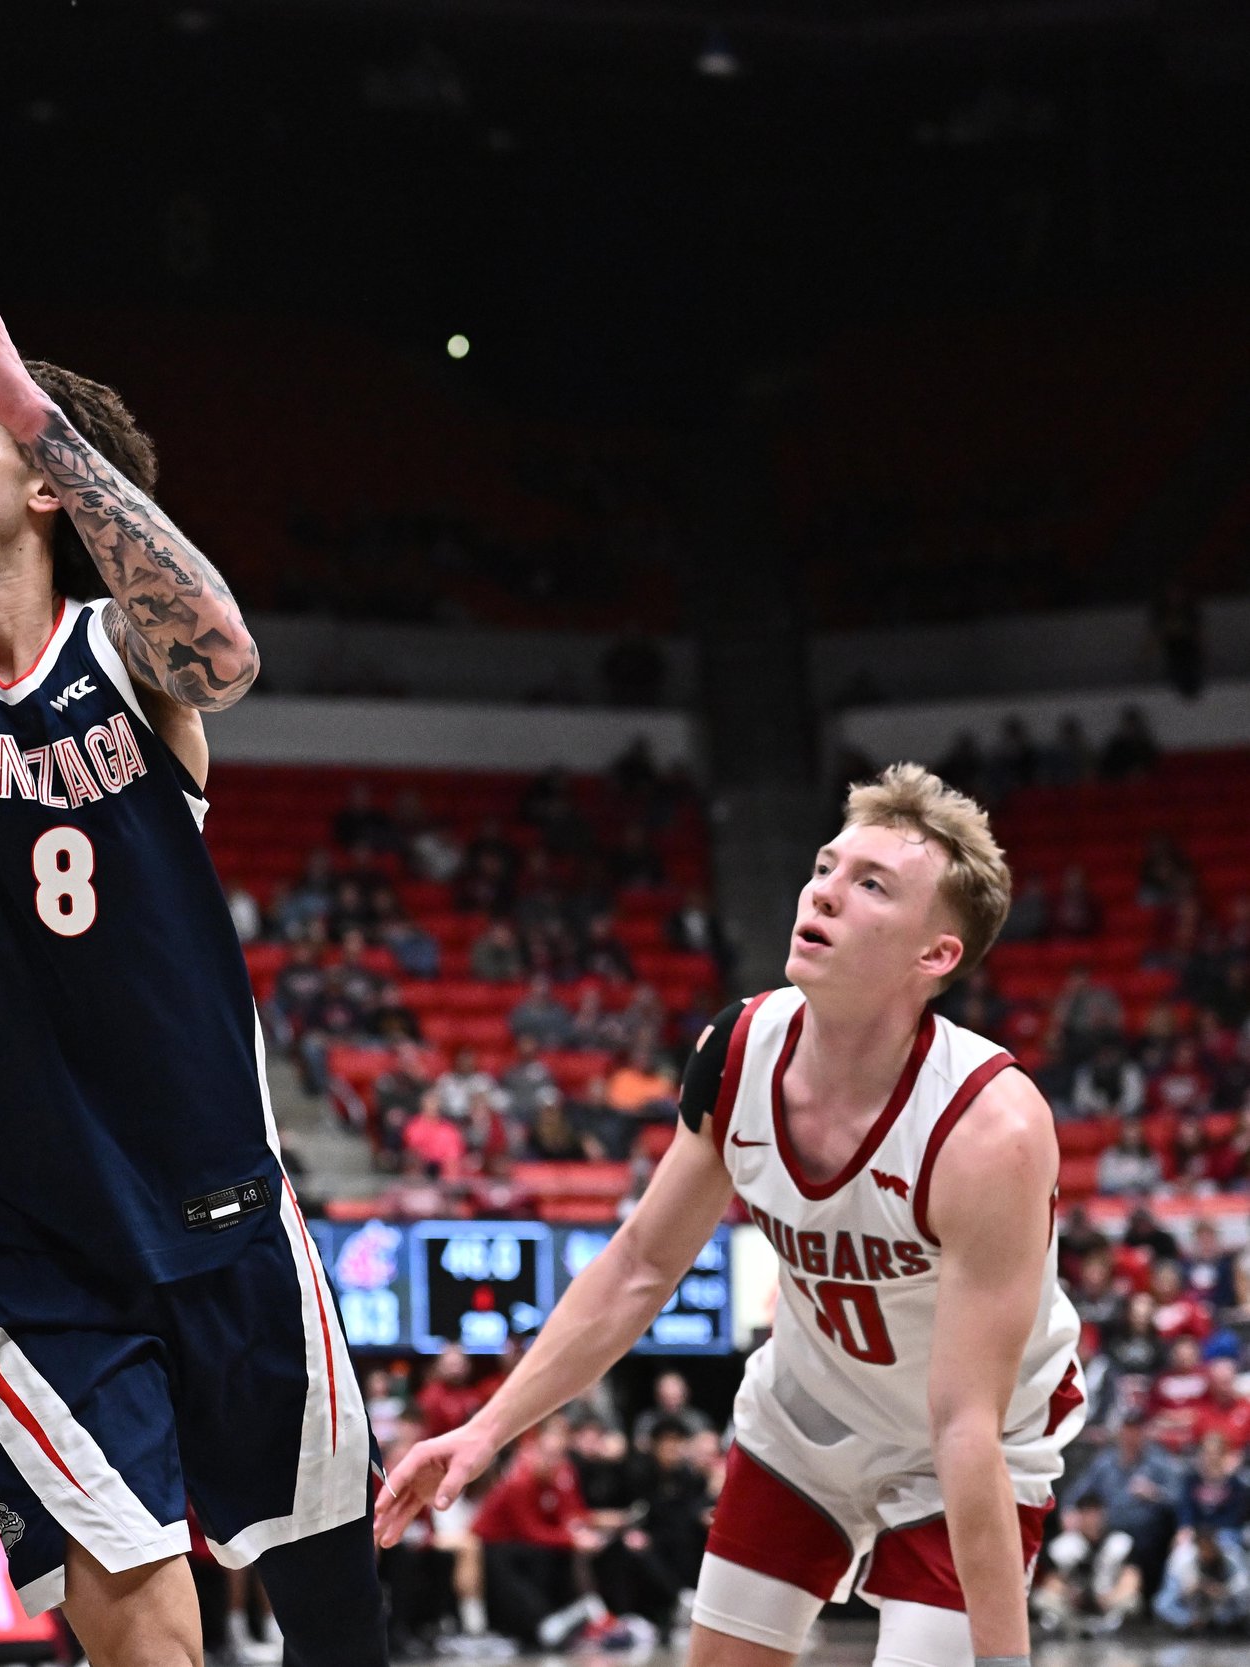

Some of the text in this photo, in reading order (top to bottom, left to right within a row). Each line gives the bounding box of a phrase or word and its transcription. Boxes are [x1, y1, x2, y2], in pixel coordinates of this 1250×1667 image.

[76, 490, 104, 509] My
[151, 546, 193, 585] Legacy
[49, 674, 97, 712] WCC
[30, 824, 98, 938] 8
[243, 1188, 258, 1203] 48
[751, 1204, 933, 1281] OUGARS
